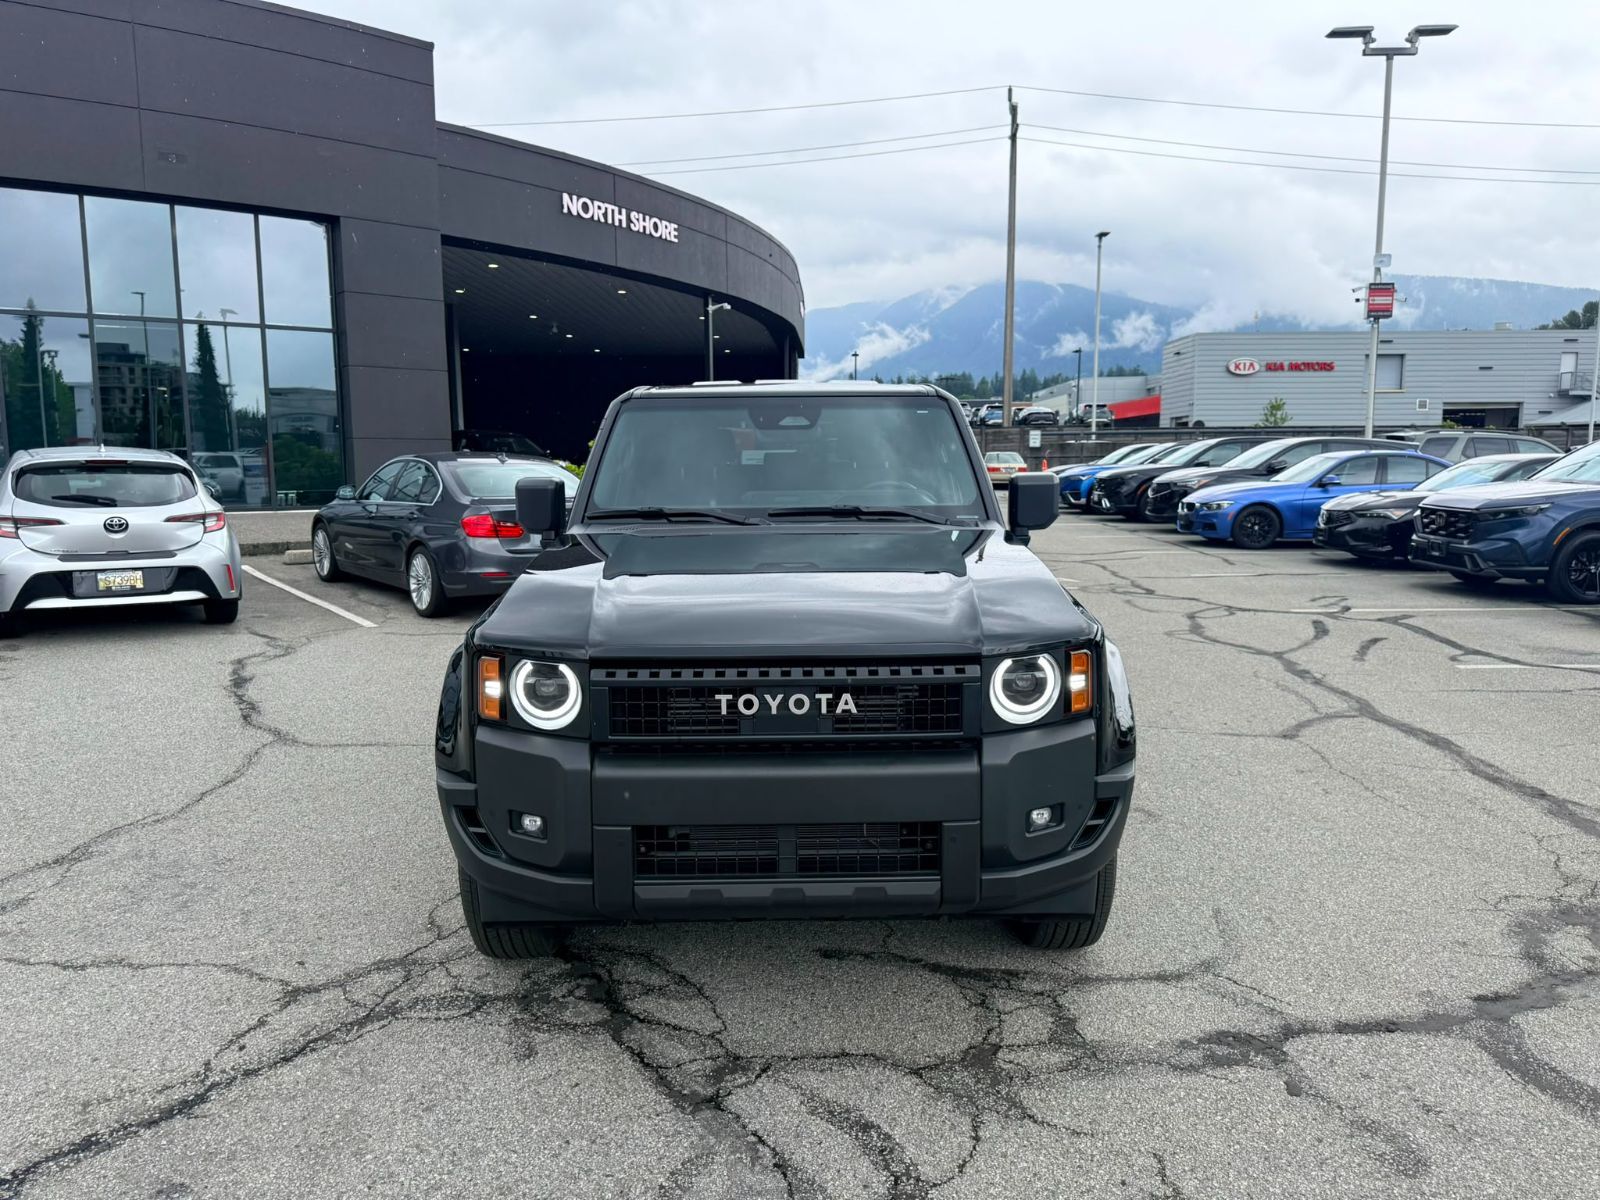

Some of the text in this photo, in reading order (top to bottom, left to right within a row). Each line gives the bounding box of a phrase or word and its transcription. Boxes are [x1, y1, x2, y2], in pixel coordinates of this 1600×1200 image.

[562, 192, 679, 243] NORTH SHORE
[1233, 362, 1256, 372] KIA
[1265, 361, 1336, 372] KIA MOTORS
[714, 693, 858, 716] TOYOTA
